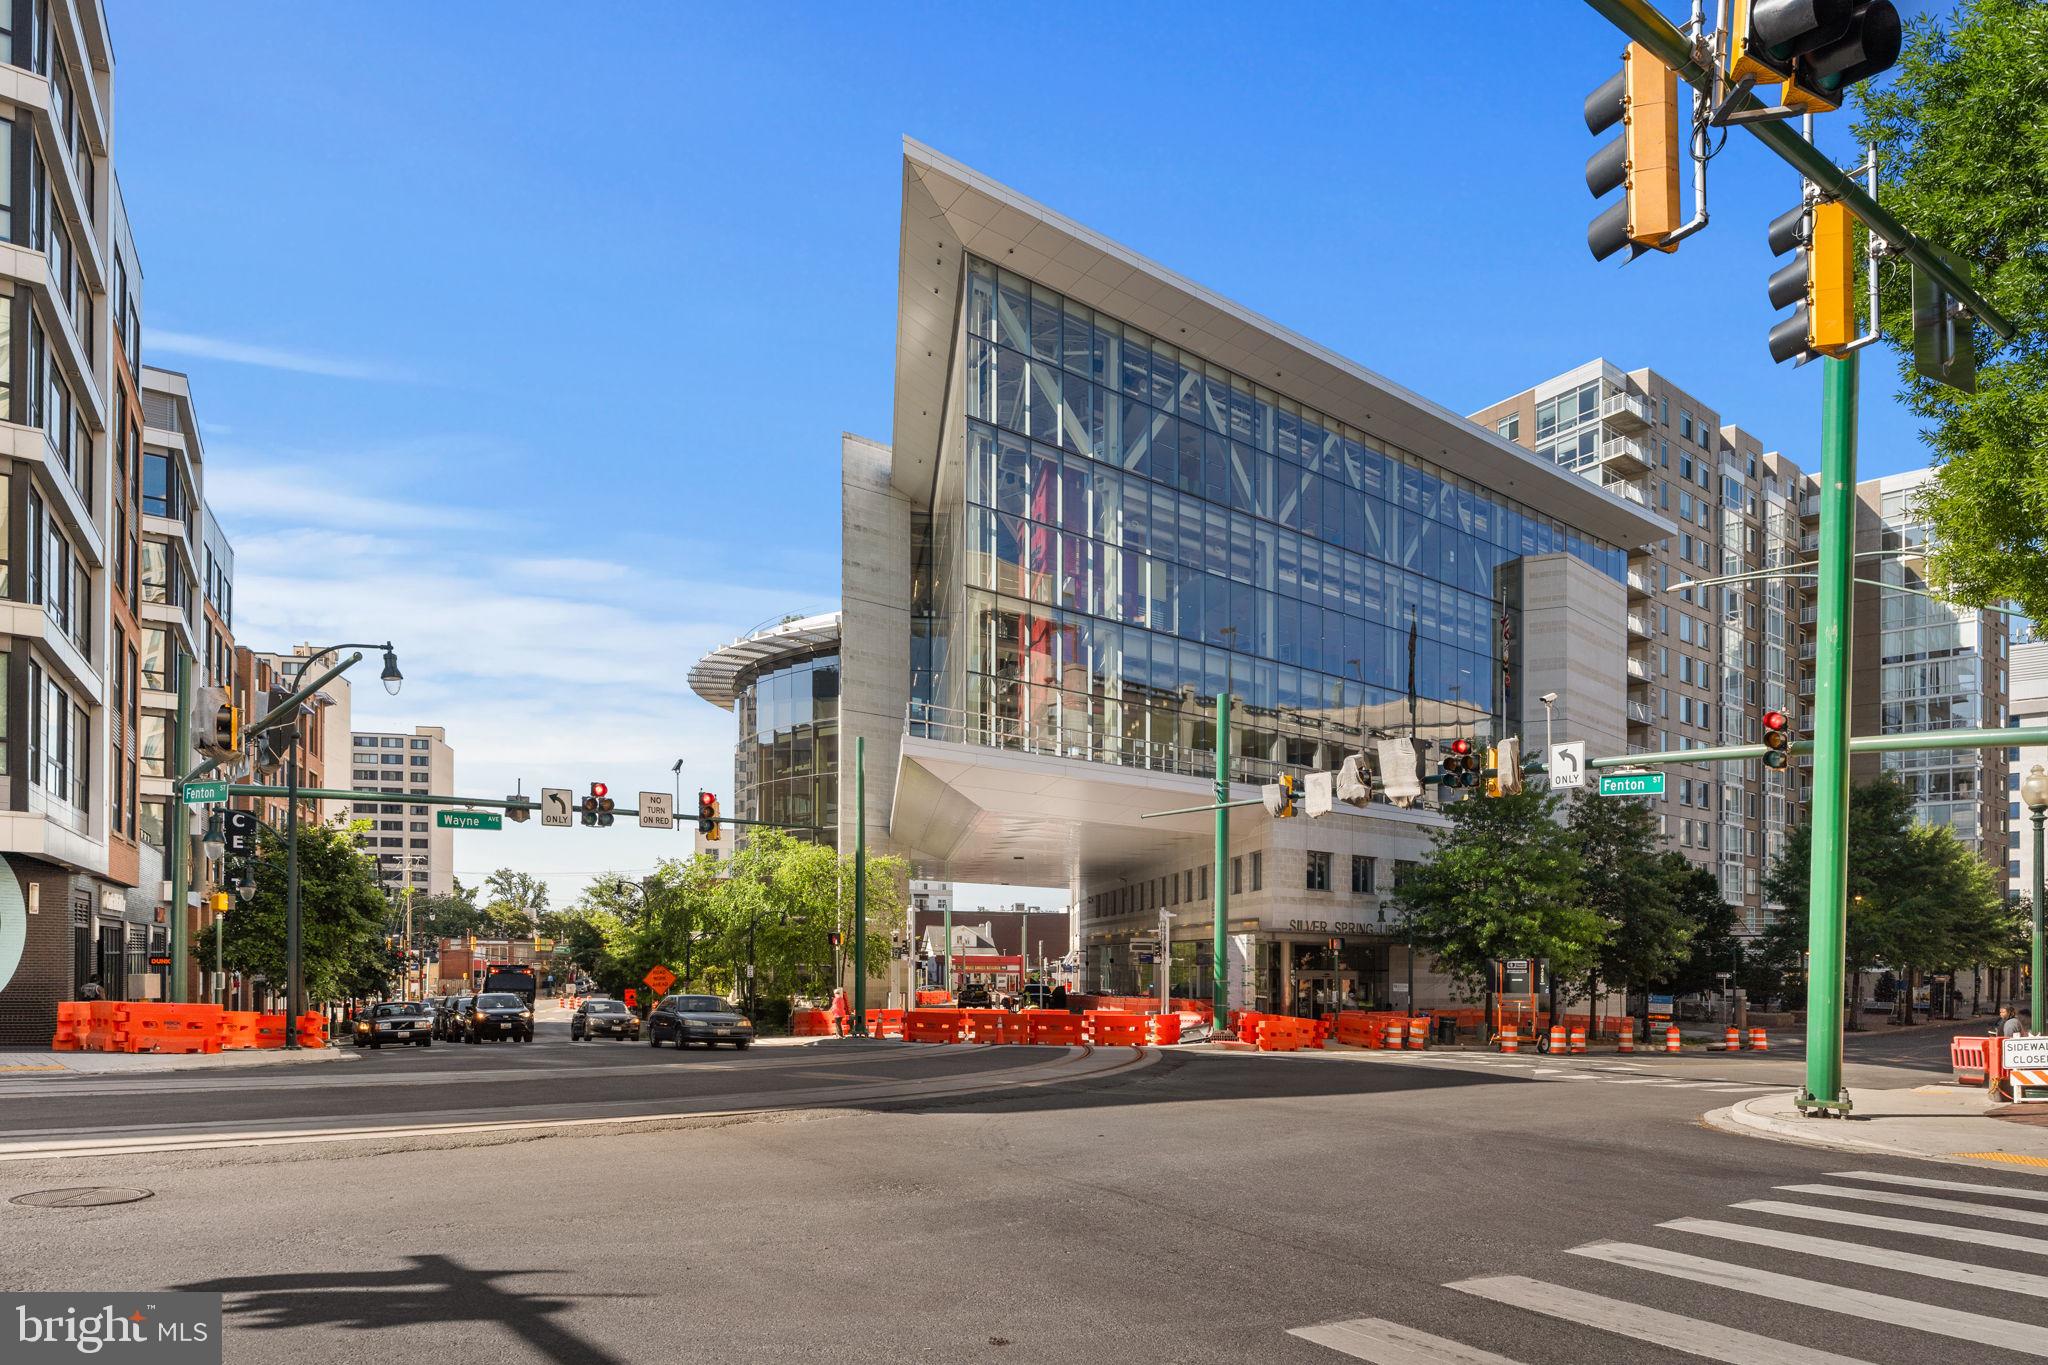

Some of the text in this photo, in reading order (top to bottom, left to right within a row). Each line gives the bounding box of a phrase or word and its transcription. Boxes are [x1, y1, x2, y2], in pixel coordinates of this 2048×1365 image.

[1555, 774, 1579, 784] ONLY
[1604, 779, 1645, 791] Fenton
[186, 788, 215, 799] Fenton
[650, 796, 662, 804] NO
[647, 806, 665, 814] TURN
[443, 814, 500, 828] Wayne AVE
[546, 815, 568, 824] ONLY
[643, 816, 670, 825] ON RED
[1289, 919, 1328, 933] SILVER
[1334, 921, 1374, 934] SPRING
[2013, 1055, 2048, 1064] CLOSE
